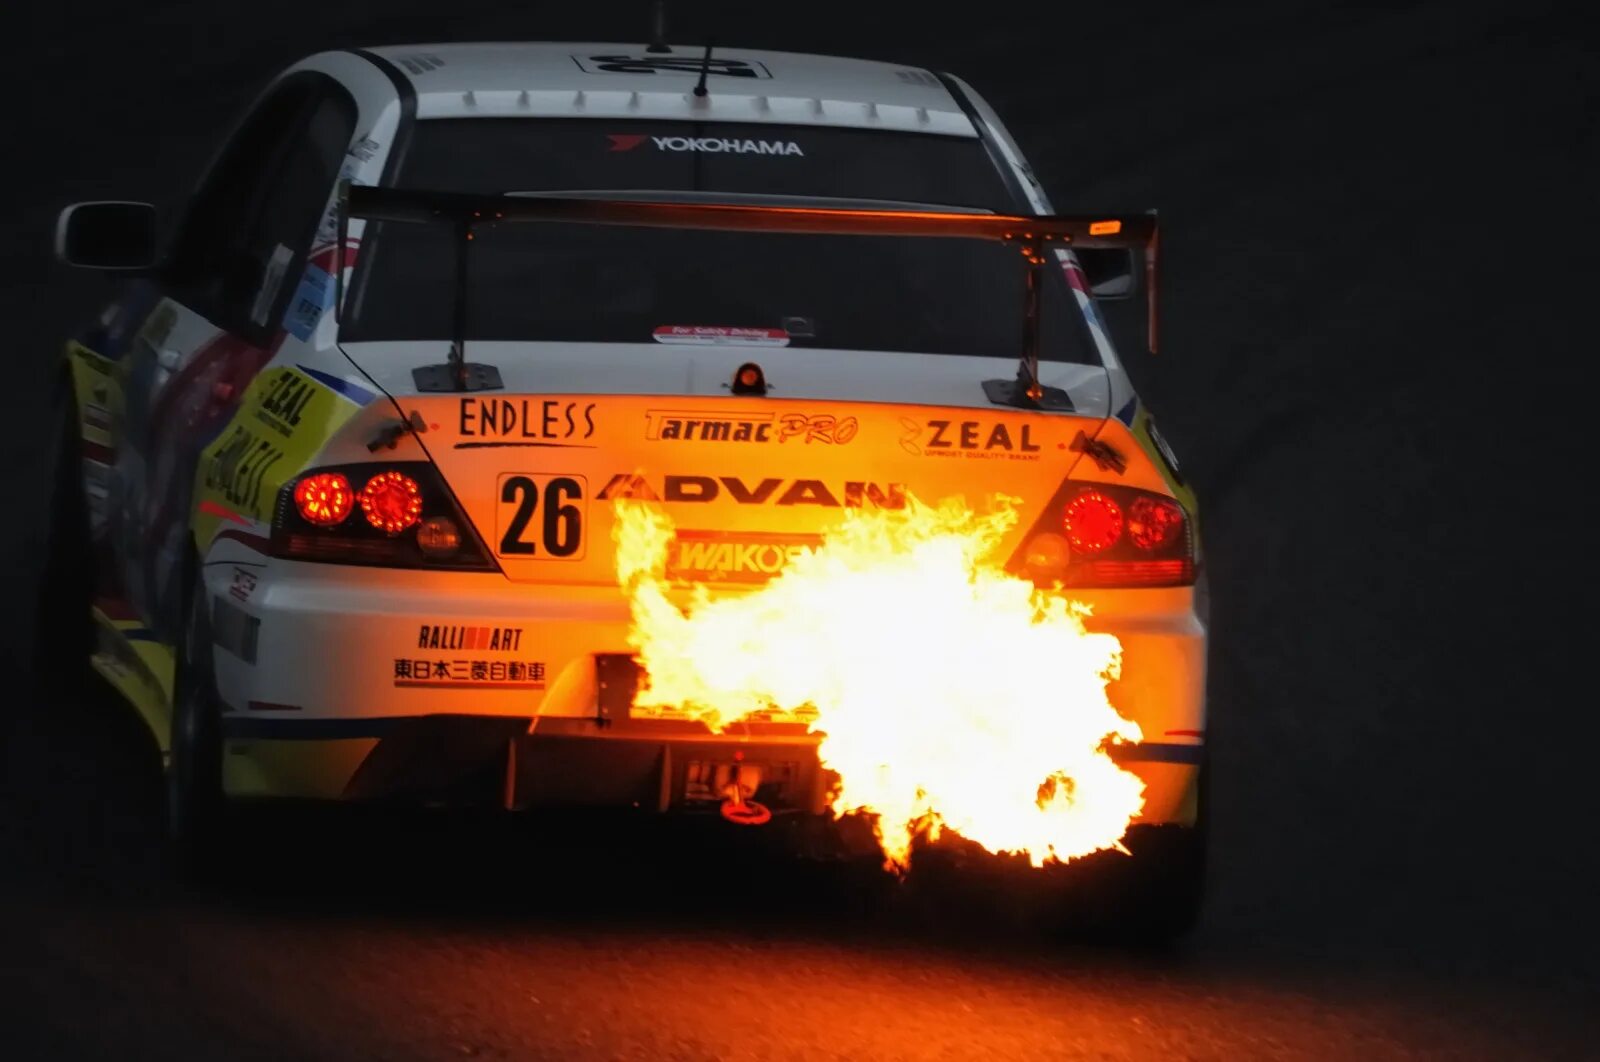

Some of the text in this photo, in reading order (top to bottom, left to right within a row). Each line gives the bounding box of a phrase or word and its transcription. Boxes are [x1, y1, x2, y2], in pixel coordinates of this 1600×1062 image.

[651, 136, 804, 156] YOKOHAMA
[459, 398, 596, 439] ENDLESS
[778, 413, 859, 444] PRO
[926, 420, 1041, 452] ZEAL
[595, 474, 907, 511] ADVAN
[500, 475, 582, 557] 26
[418, 624, 524, 651] RALLI ART
[394, 658, 546, 682] 東日本三菱自動車
